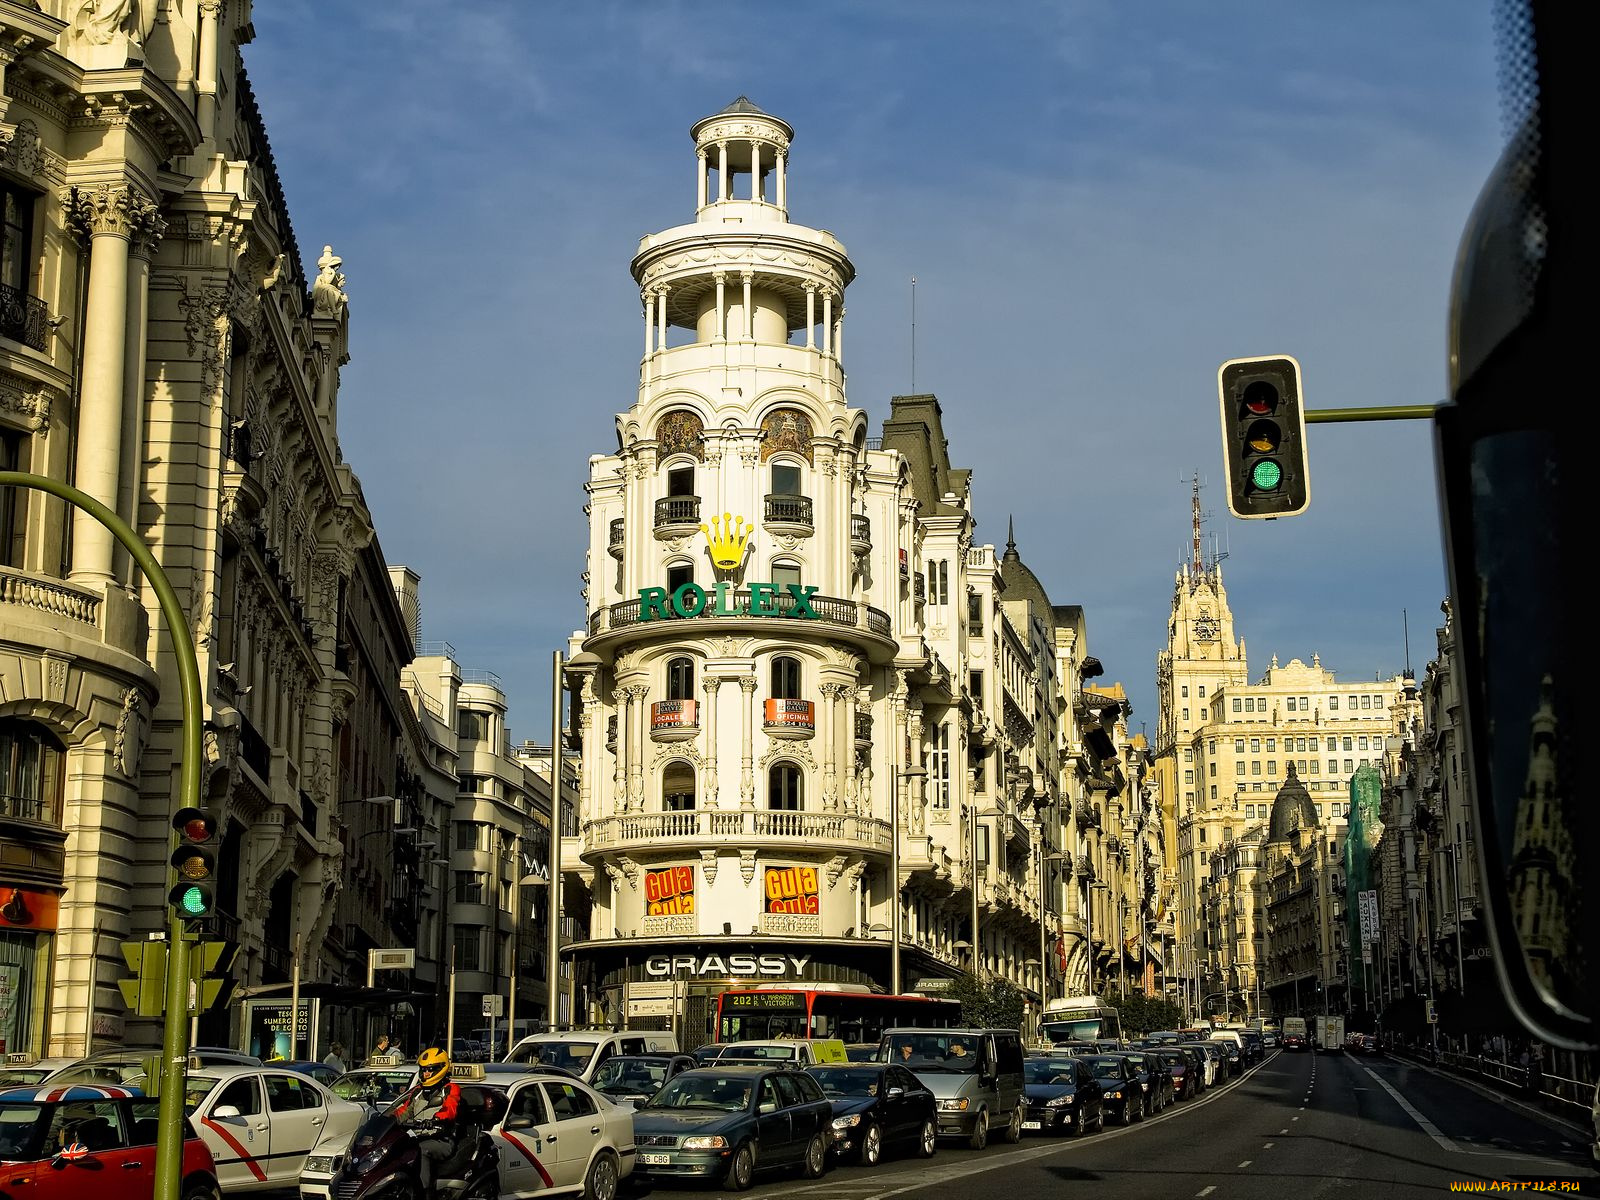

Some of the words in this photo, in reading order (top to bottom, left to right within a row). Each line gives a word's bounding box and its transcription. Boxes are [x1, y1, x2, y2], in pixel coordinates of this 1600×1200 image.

[638, 582, 821, 621] ROLEX
[776, 713, 809, 721] OFICINAS
[645, 866, 694, 902] Gula
[765, 867, 819, 900] Gula
[645, 953, 812, 976] GRASSY
[733, 996, 752, 1005] 202
[277, 1010, 309, 1018] TESOOS
[263, 1017, 308, 1025] SUMERGOS
[270, 1024, 281, 1032] DE
[283, 1024, 308, 1032] EGTO
[13, 1055, 26, 1063] TAXI
[454, 1066, 472, 1076] TAXI
[653, 1155, 668, 1163] CBG
